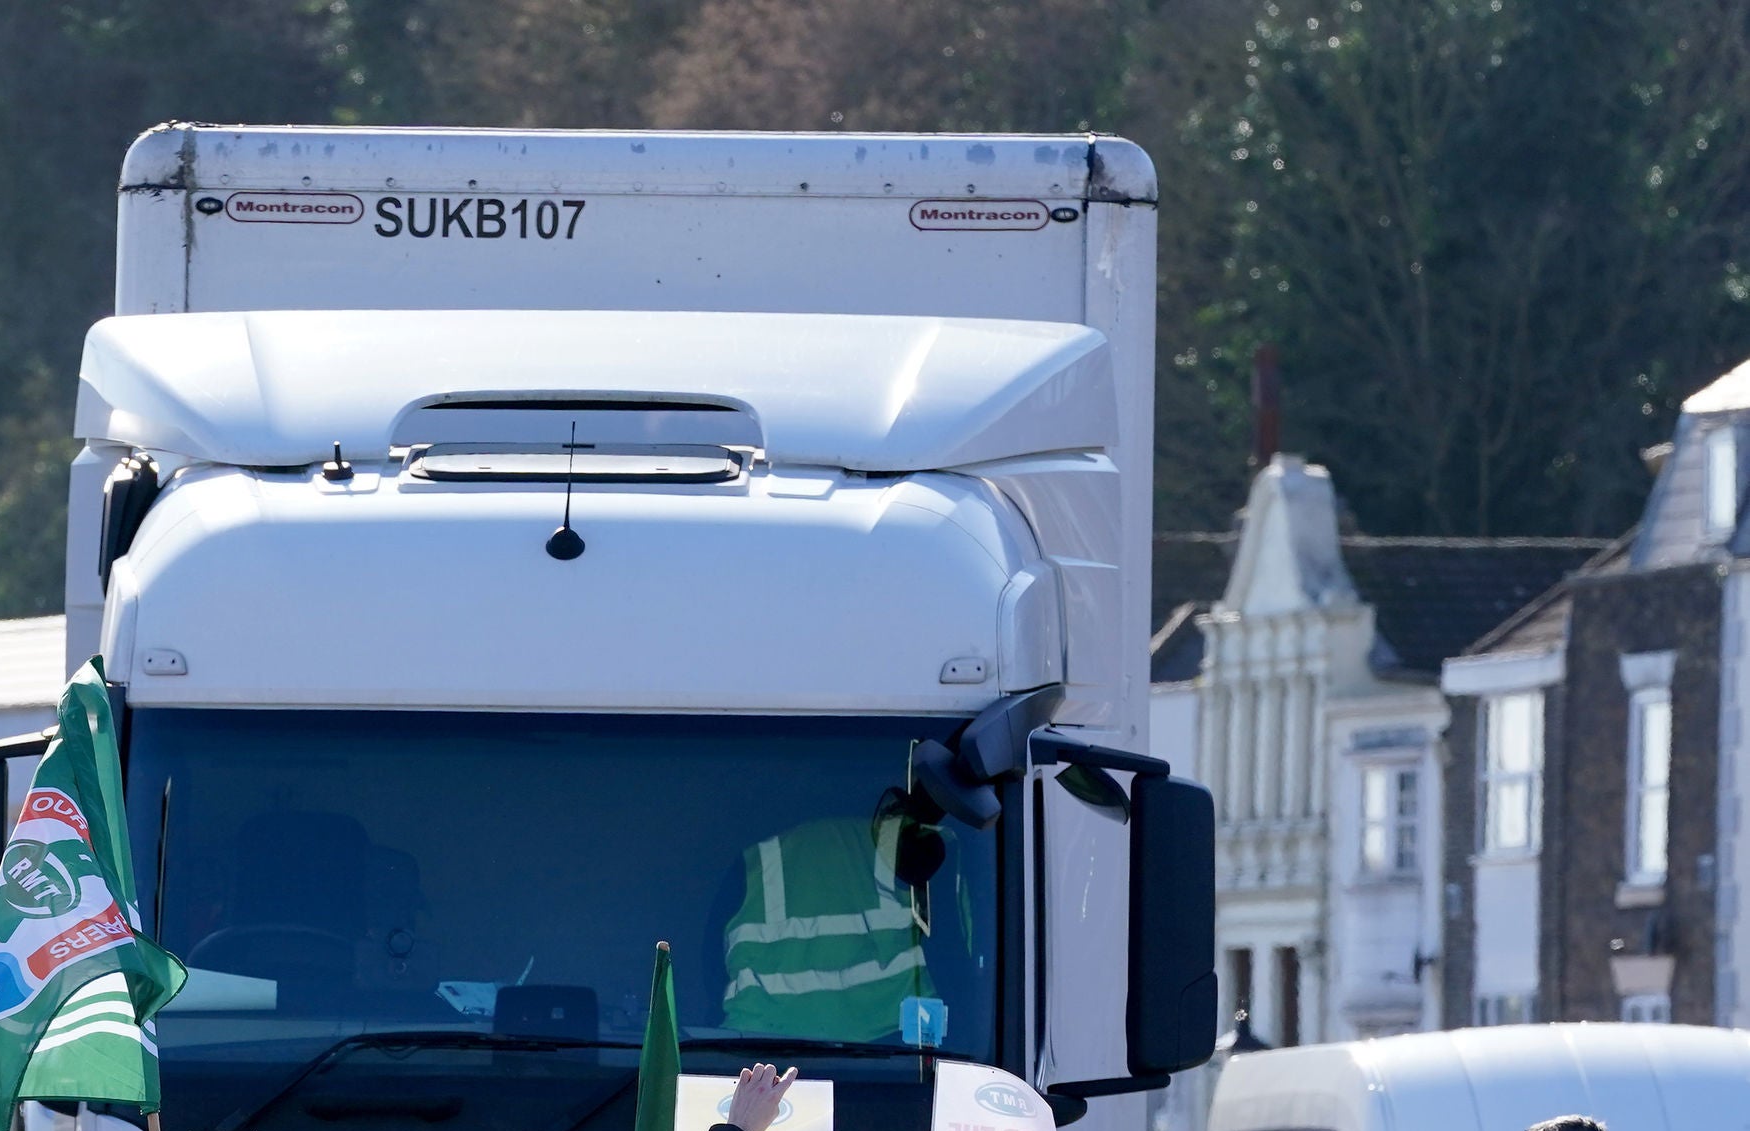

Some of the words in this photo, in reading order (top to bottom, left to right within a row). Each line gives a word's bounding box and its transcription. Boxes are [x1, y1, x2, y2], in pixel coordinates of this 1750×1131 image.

[235, 200, 355, 214] Montracon
[374, 196, 587, 240] SUKB107
[920, 208, 1040, 221] Montracon
[32, 796, 88, 830] OUR
[7, 856, 63, 901] RMT
